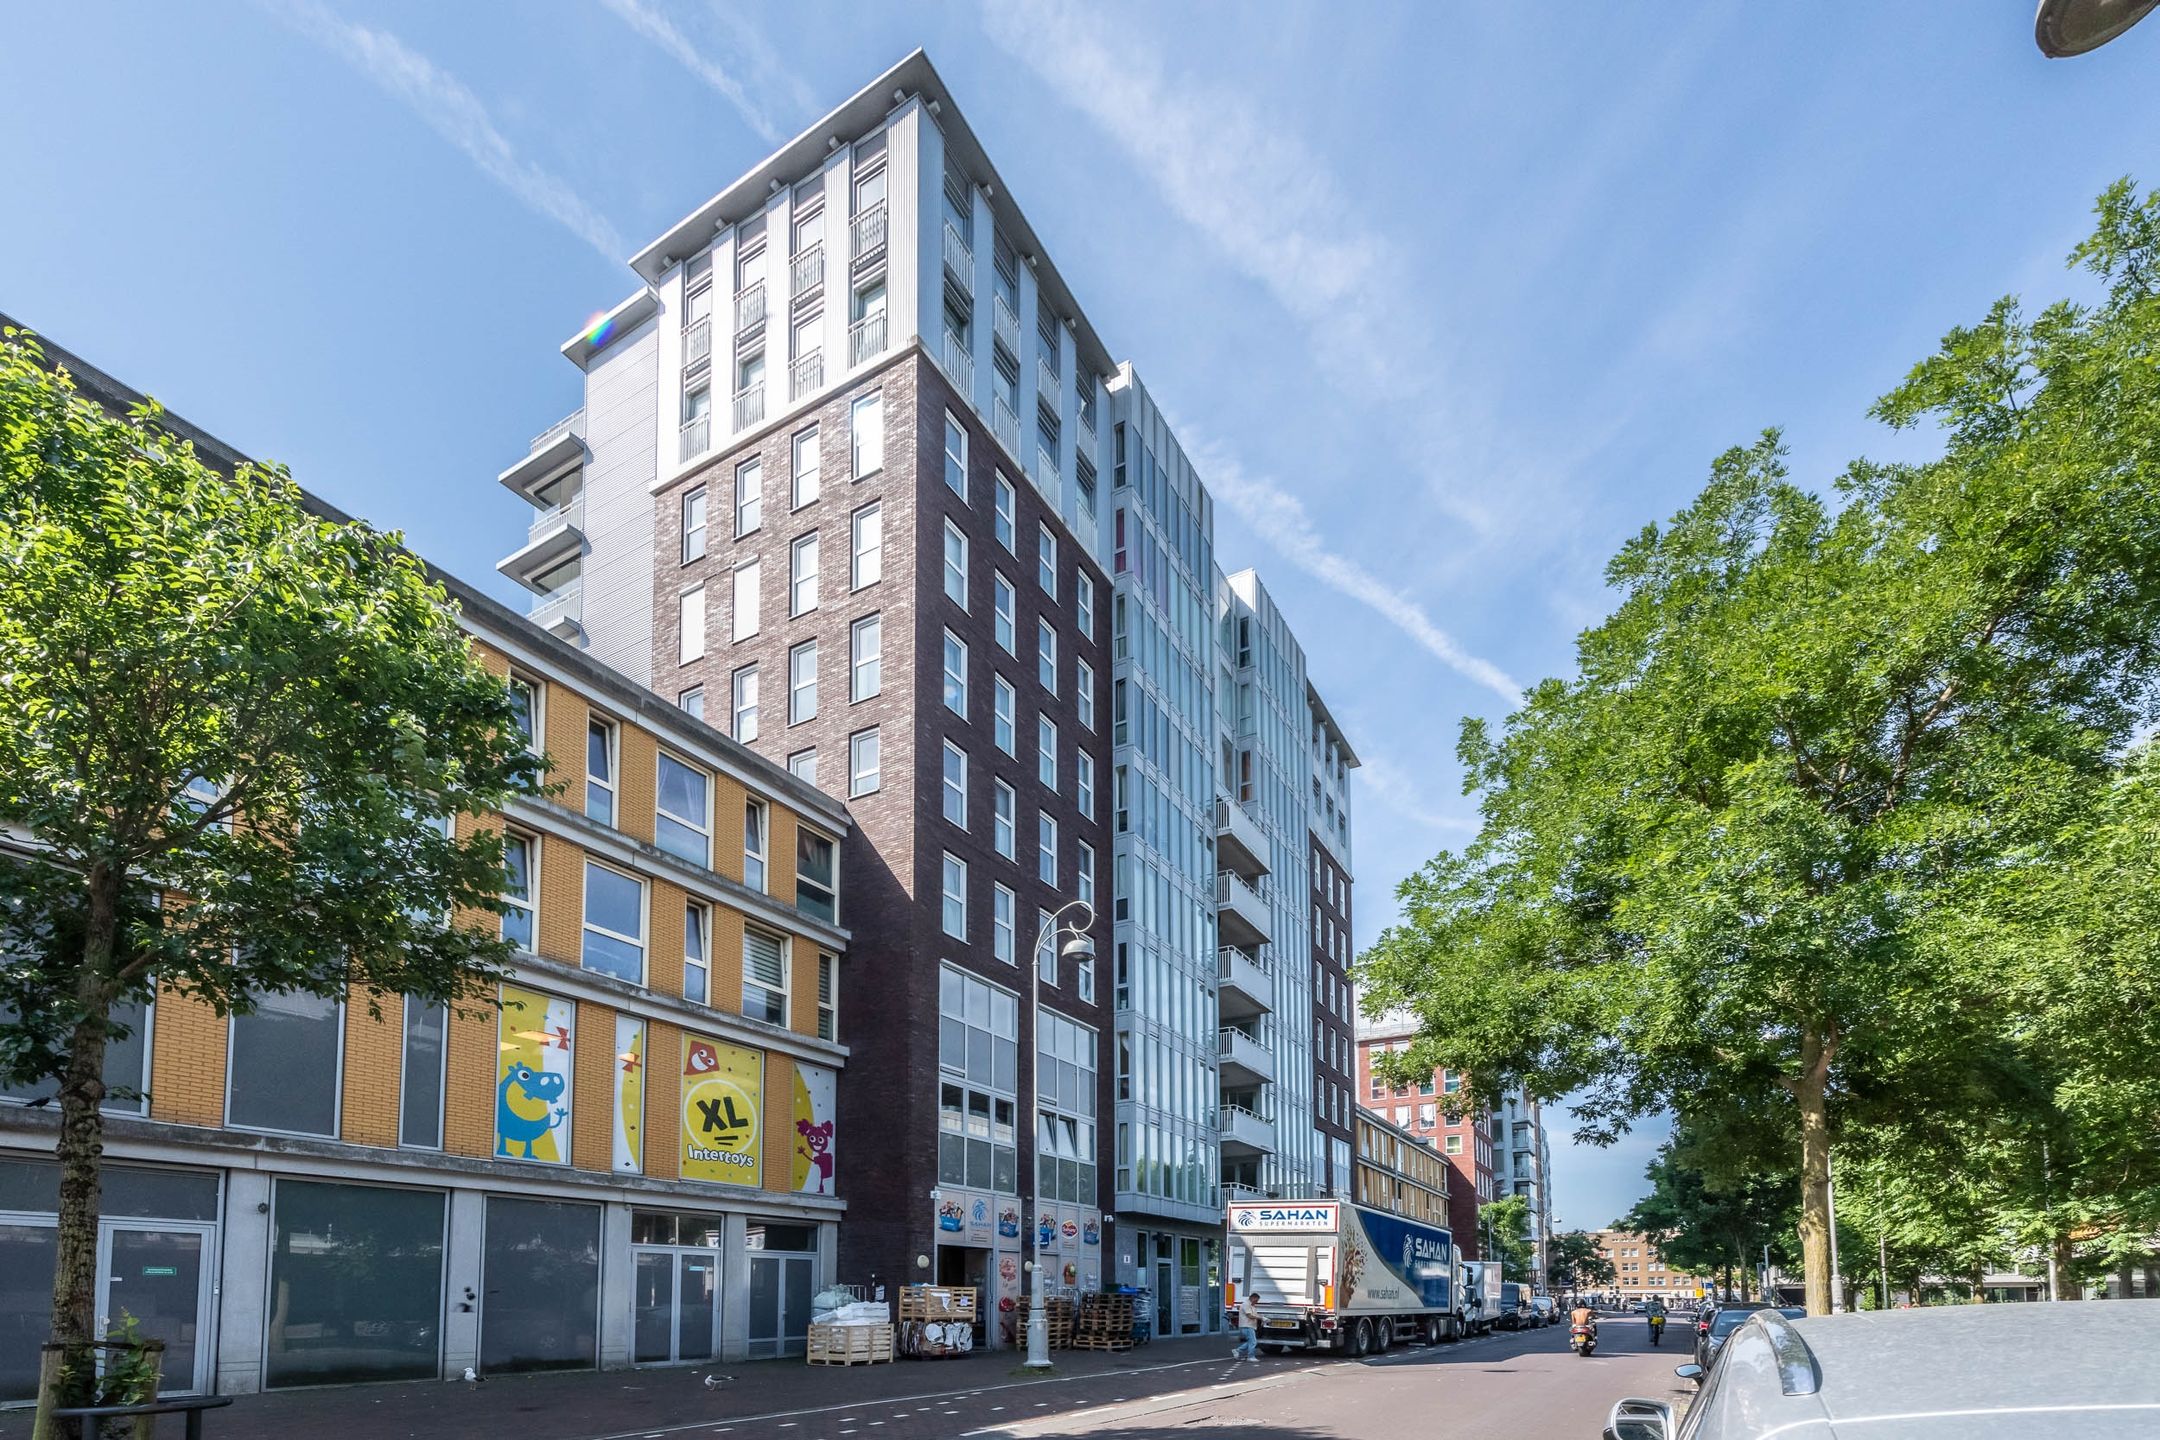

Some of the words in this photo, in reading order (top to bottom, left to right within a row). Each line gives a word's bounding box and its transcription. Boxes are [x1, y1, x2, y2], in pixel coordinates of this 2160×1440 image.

[696, 1096, 749, 1132] XL
[687, 1144, 755, 1168] Intertoys
[1260, 1209, 1328, 1220] SAHAN
[1415, 1237, 1448, 1261] SAHAN
[1367, 1285, 1400, 1300] www.sahan.nl
